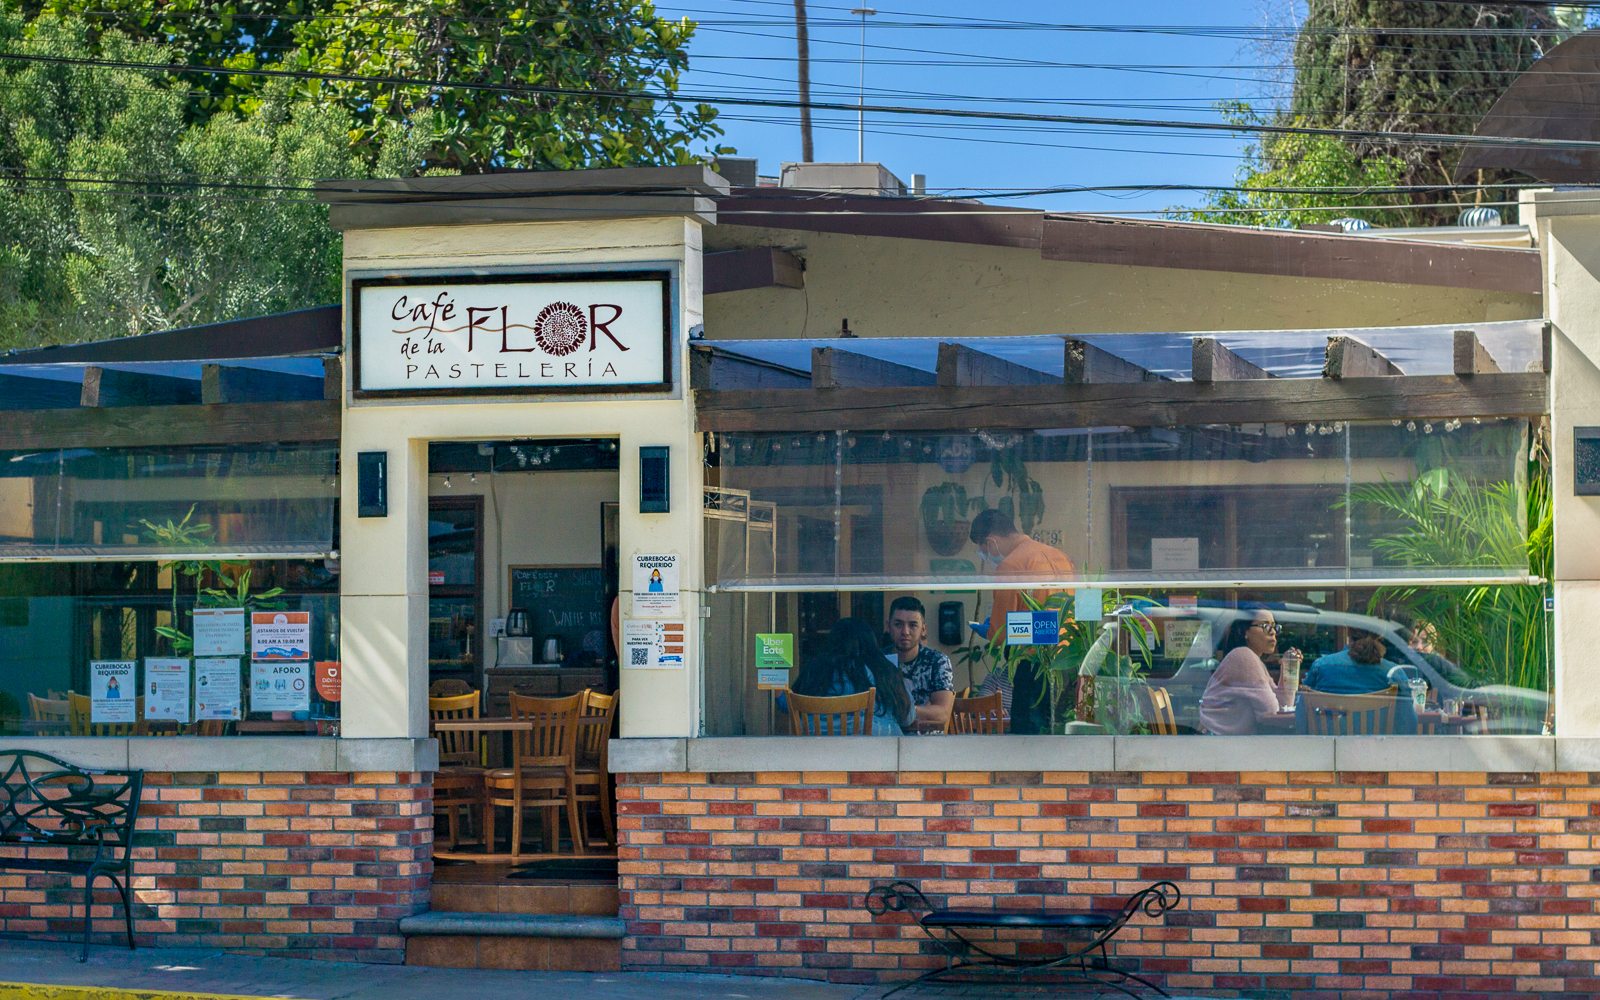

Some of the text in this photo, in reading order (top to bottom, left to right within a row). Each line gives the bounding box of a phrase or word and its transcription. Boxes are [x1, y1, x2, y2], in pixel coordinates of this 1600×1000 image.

[391, 292, 456, 338] Café
[466, 301, 630, 357] FLOR
[400, 338, 446, 359] de la
[407, 358, 618, 379] PASTELERÍA
[1034, 620, 1057, 629] OPEN
[763, 638, 784, 646] Uber
[763, 646, 784, 654] Eats
